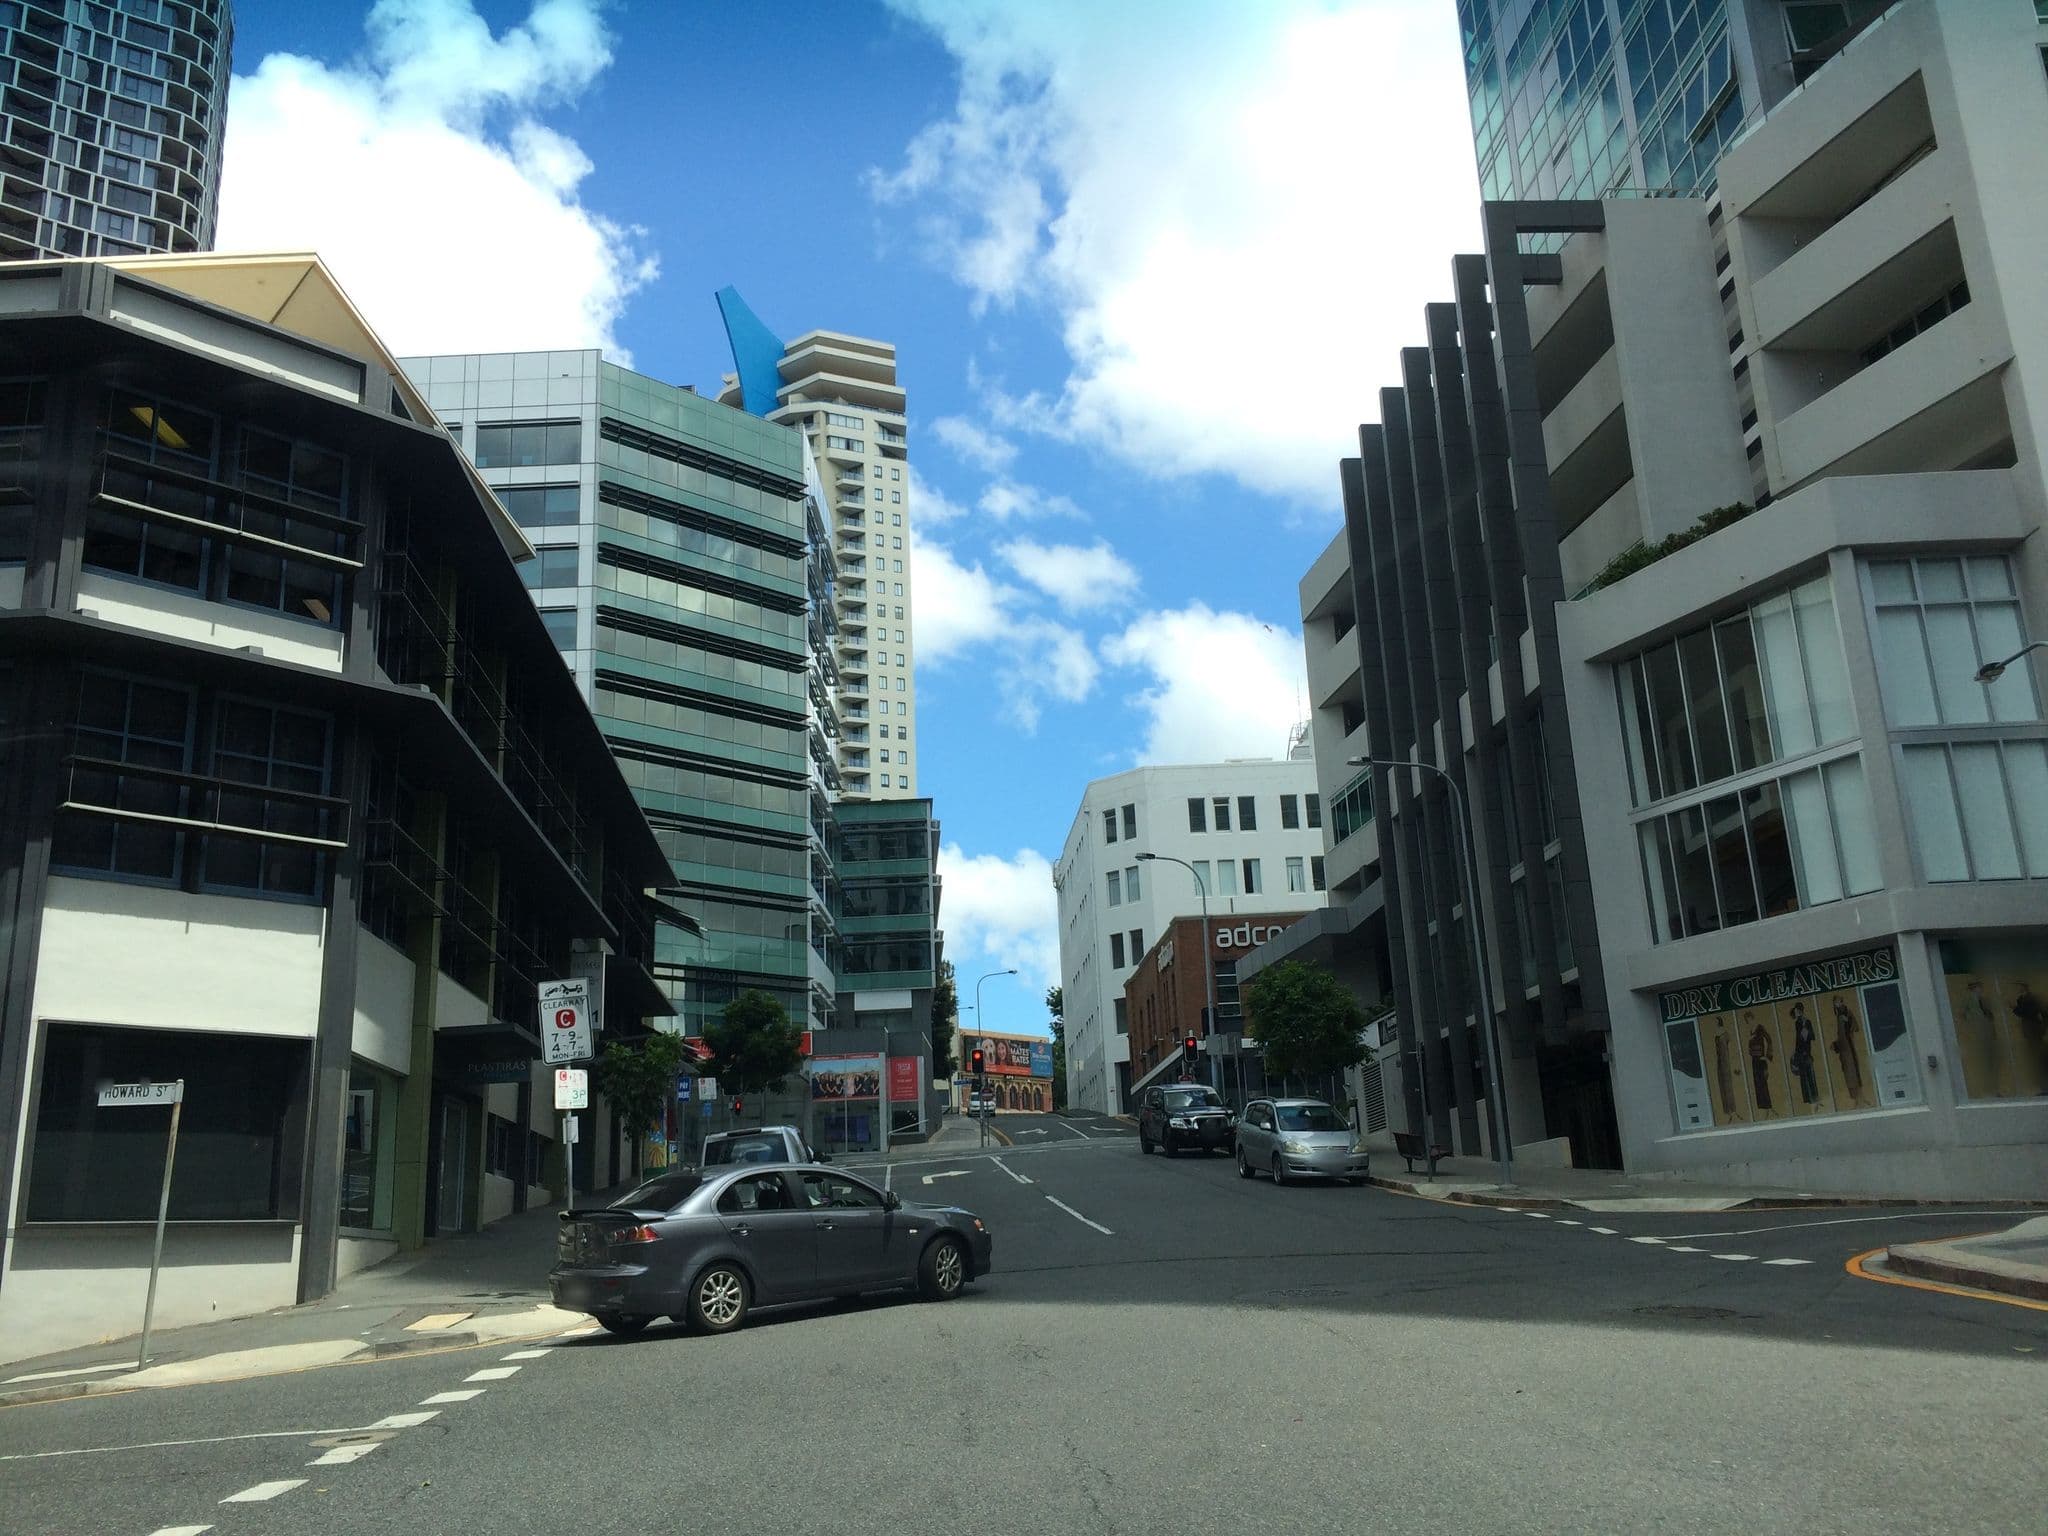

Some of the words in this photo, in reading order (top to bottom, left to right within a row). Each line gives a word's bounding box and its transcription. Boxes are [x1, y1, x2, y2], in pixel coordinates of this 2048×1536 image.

[1216, 921, 1292, 948] adco
[1664, 984, 1722, 1020] DRY
[1729, 950, 1895, 1007] CLEANERS
[543, 998, 585, 1010] CLEARWAY
[560, 1011, 571, 1026] C
[104, 1085, 150, 1099] HOWARD
[156, 1085, 169, 1097] ST
